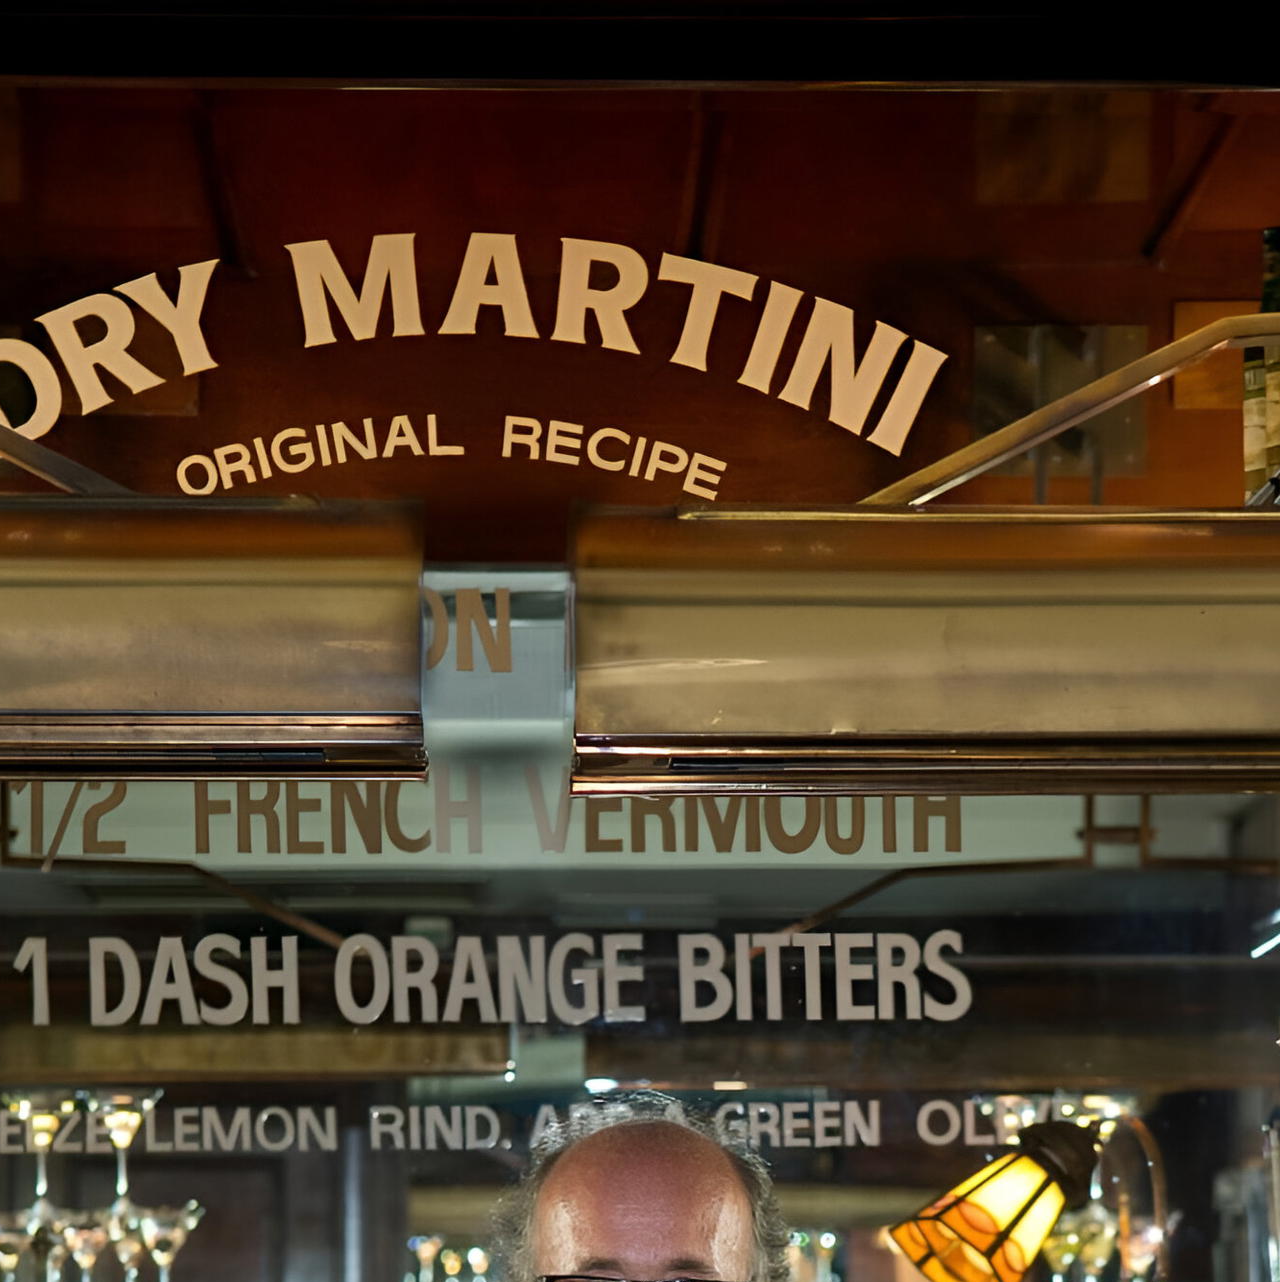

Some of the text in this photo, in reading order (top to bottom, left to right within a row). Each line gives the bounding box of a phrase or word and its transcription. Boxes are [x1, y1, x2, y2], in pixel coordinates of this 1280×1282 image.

[284, 232, 949, 457] MARTINI
[176, 413, 728, 501] ORIGINAL RECIPE
[10, 765, 962, 873] 1/2 FRENCH VERMOUTH
[13, 929, 973, 1026] 1 DASH ORANGE BITTERS
[145, 1105, 337, 1153] LEMON
[714, 1101, 881, 1148] GREEN
